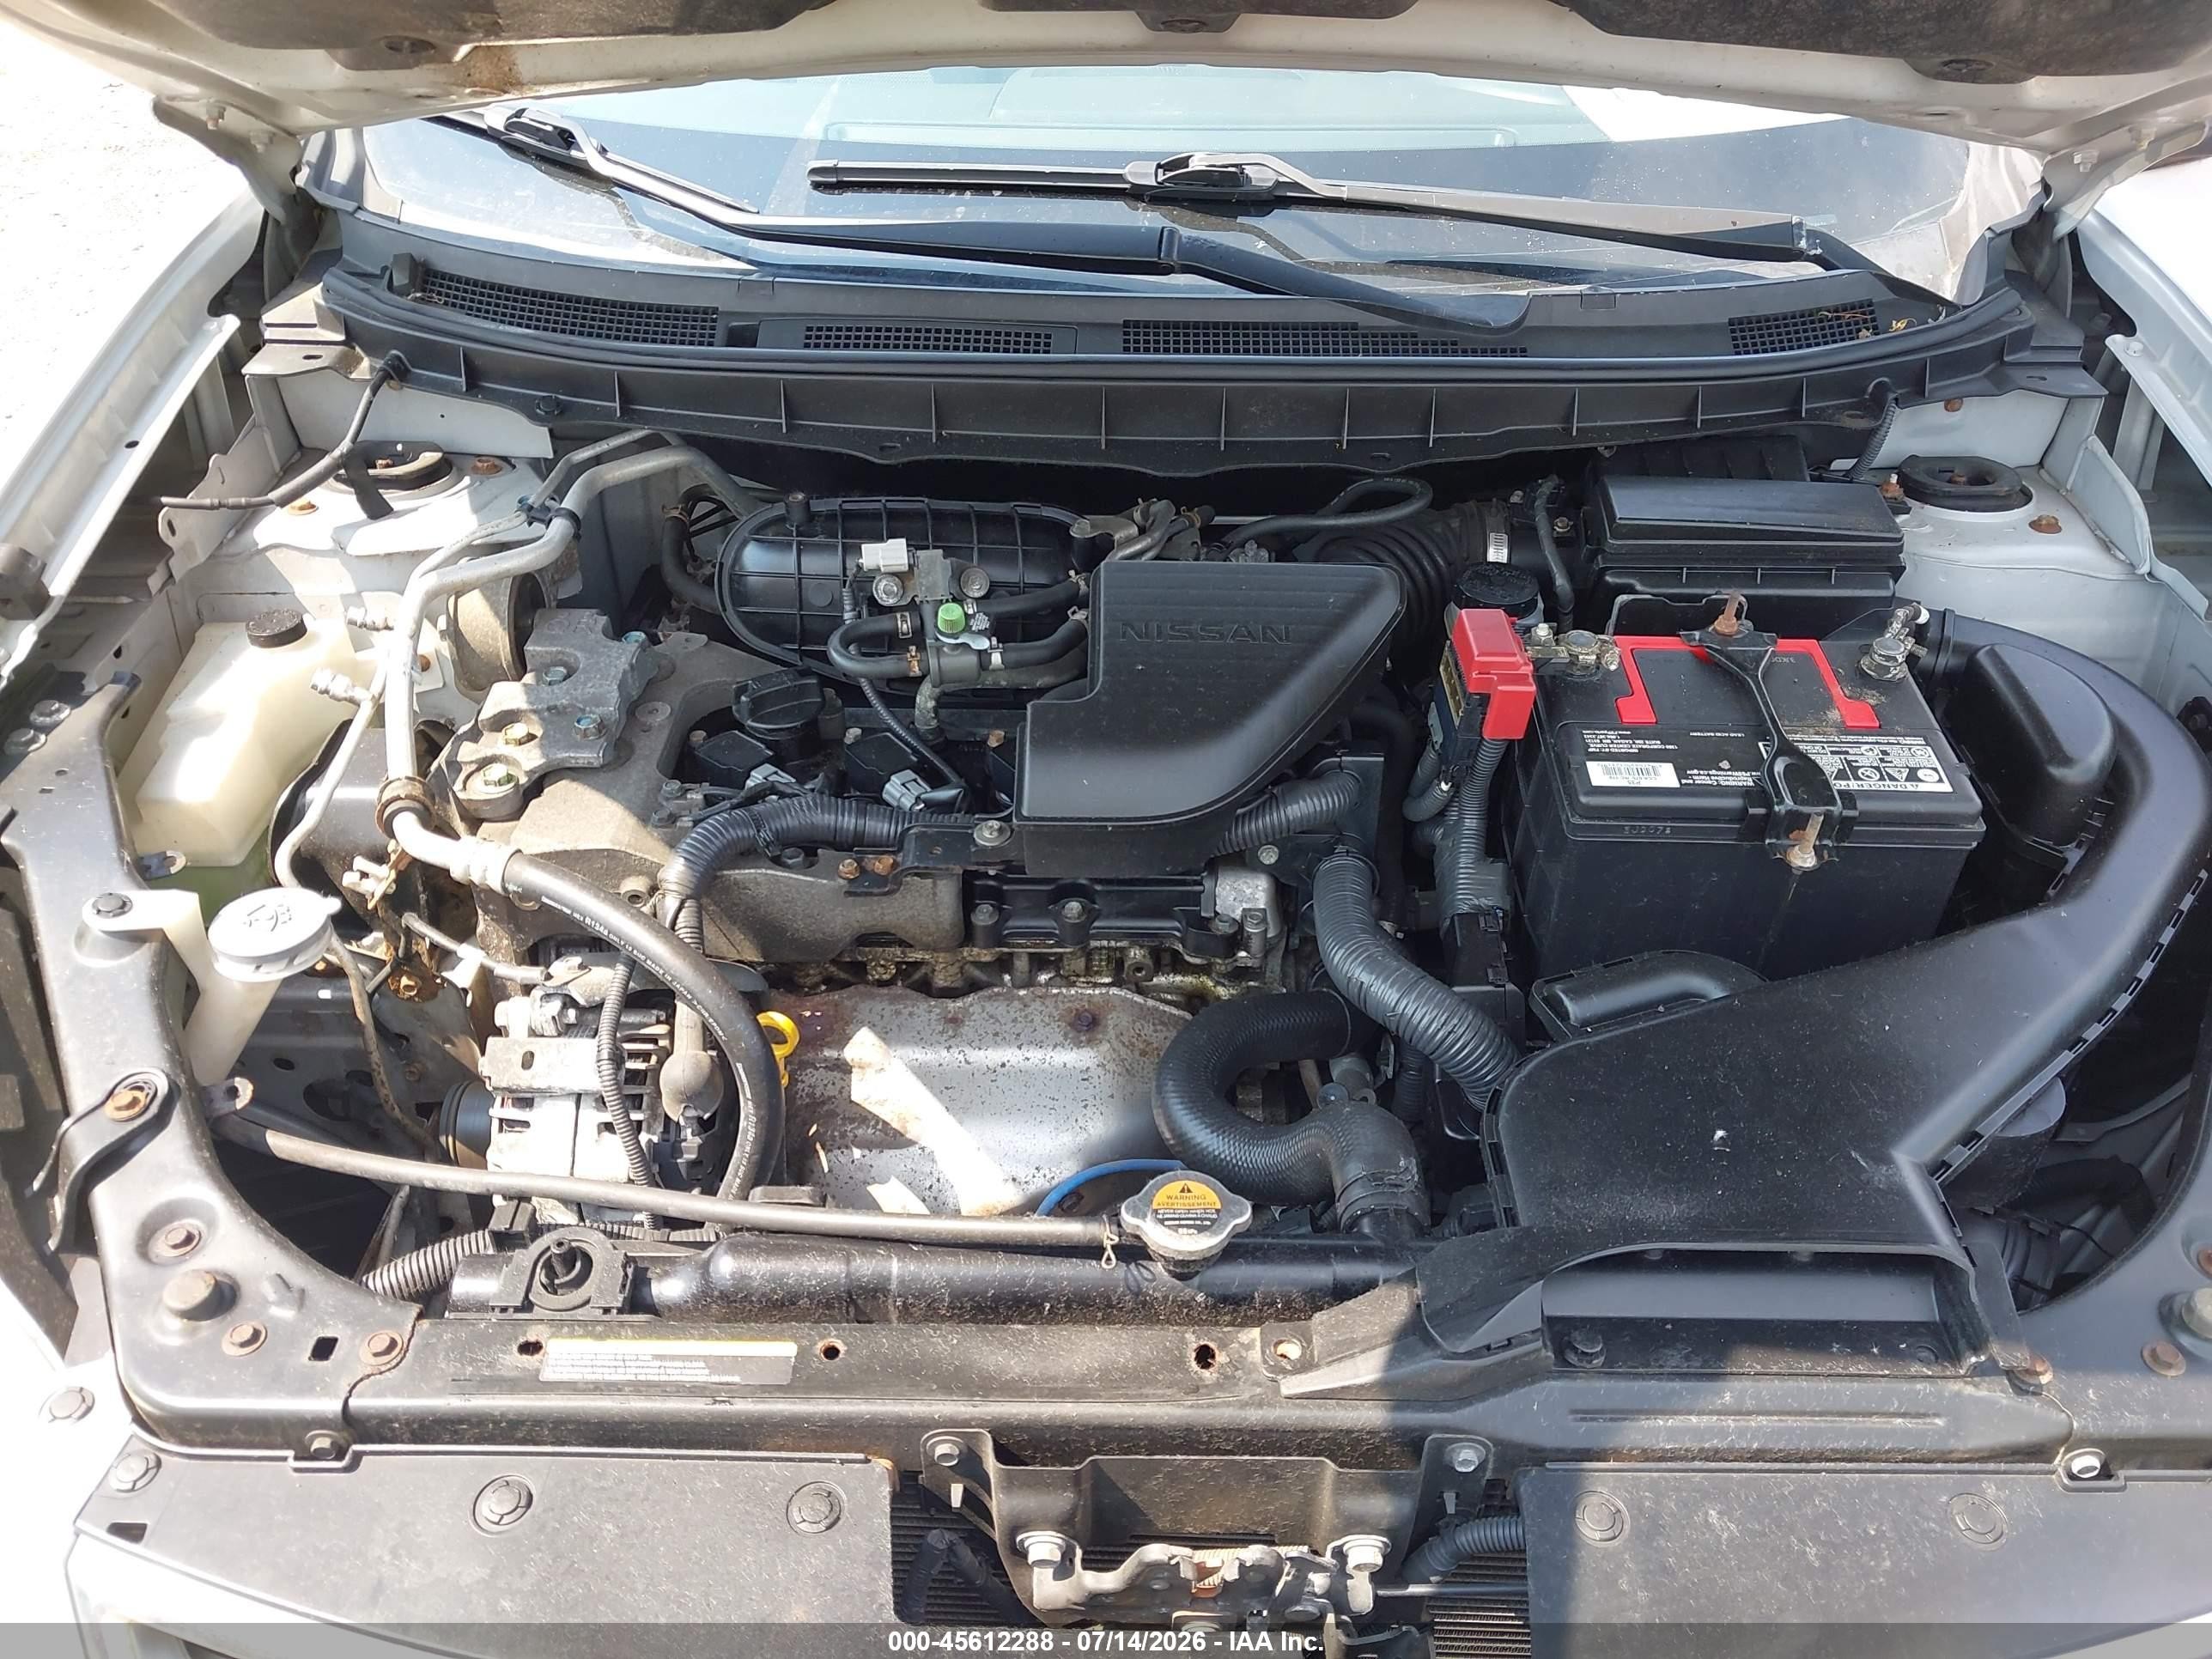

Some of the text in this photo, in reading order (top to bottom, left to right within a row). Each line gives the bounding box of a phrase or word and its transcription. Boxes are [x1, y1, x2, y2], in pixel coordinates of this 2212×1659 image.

[1119, 622, 1291, 645] NISSAN
[584, 916, 609, 936] R134a
[608, 933, 625, 946] ONLY
[646, 959, 665, 975] MADE
[672, 980, 693, 999] JAPAN
